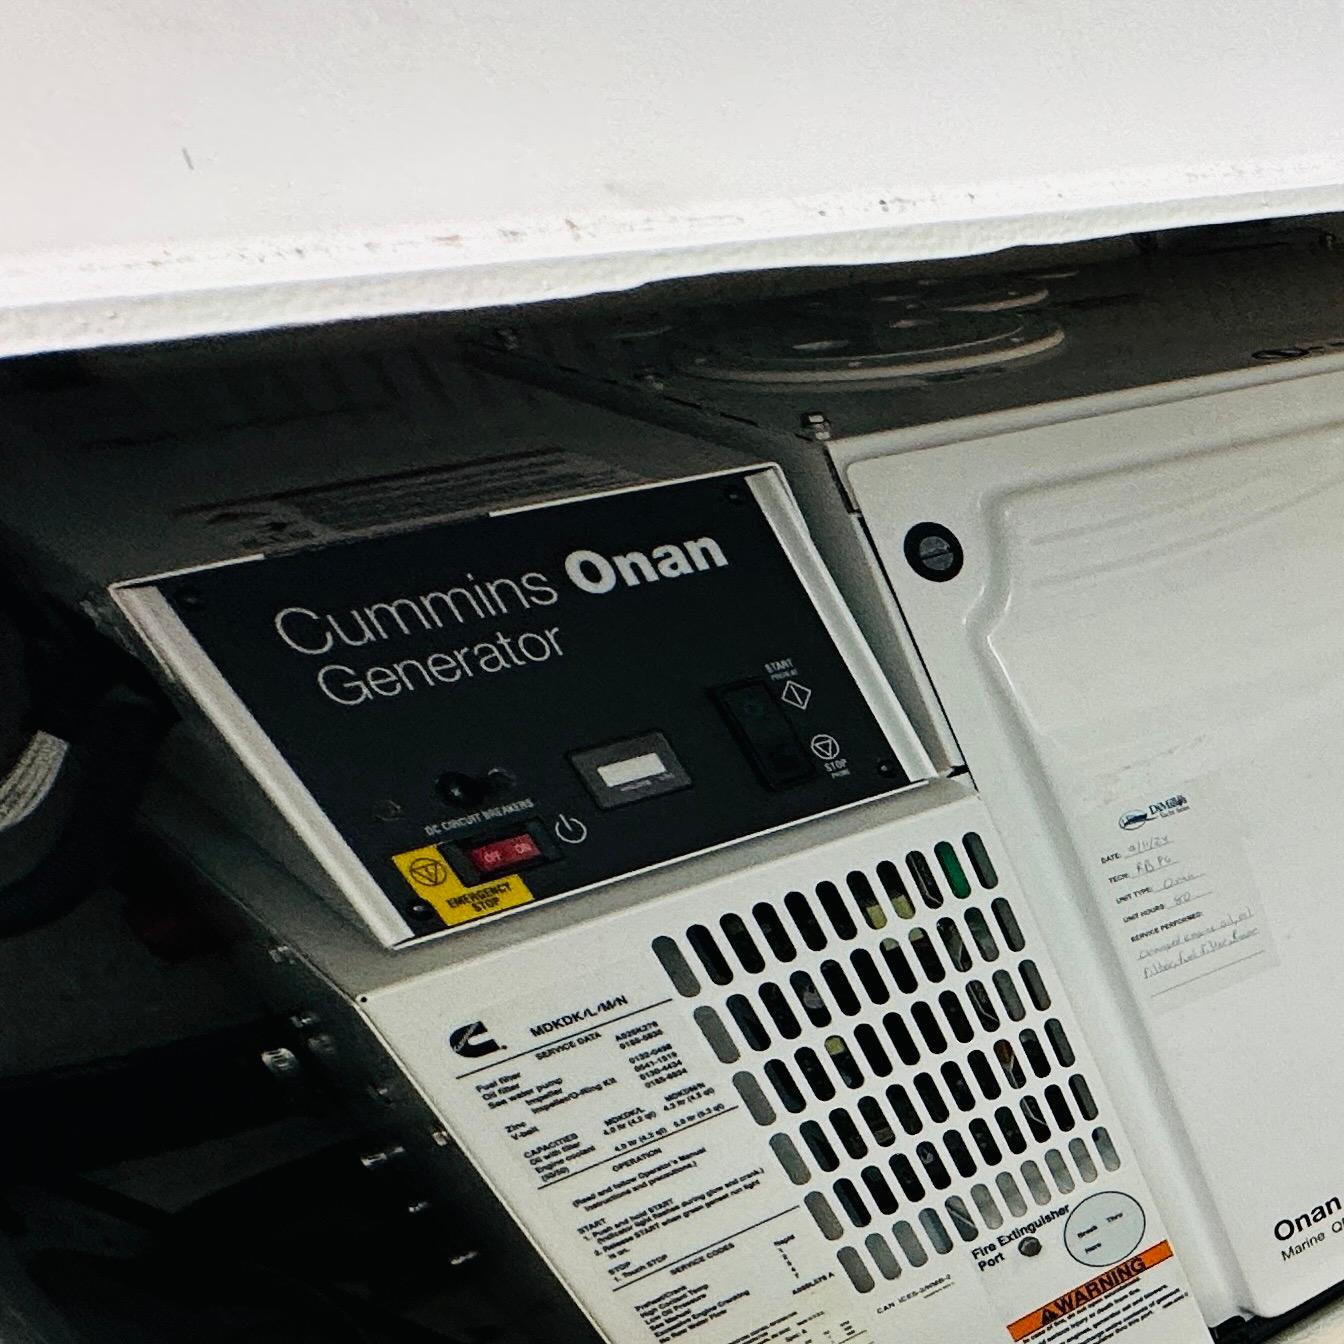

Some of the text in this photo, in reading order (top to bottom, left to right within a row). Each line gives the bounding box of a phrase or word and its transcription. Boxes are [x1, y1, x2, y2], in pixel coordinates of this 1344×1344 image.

[274, 536, 729, 658] Cummins Onan
[318, 624, 565, 708] Generator
[764, 658, 794, 674] START
[824, 758, 847, 772] STOP
[424, 798, 535, 836] DC CIRCUIT BREAKERS
[446, 882, 512, 908] EMERGENCY
[470, 897, 501, 912] STOP
[535, 1031, 601, 1060] SERVICE DATA
[475, 1072, 521, 1093] Fuel filter
[497, 1083, 520, 1095] filter
[508, 1088, 534, 1101] water
[535, 1077, 563, 1093] pump
[523, 1132, 578, 1158] CAPACITIES
[561, 1141, 580, 1152] filter
[534, 1158, 565, 1174] Engine
[597, 1185, 613, 1196] and
[612, 1176, 637, 1189] follow
[677, 1147, 706, 1161] Manual
[612, 1147, 662, 1172] OPERATION
[631, 1181, 648, 1192] and
[633, 1216, 653, 1227] light
[681, 1193, 706, 1207] during
[705, 1185, 723, 1197] glow
[724, 1178, 739, 1188] and
[633, 1221, 660, 1238] START
[661, 1214, 682, 1226] when
[682, 1204, 704, 1218] green
[730, 1187, 743, 1196] run
[742, 1179, 760, 1190] light
[577, 1217, 606, 1234] START
[591, 1197, 673, 1238] Push and hold START
[1273, 1196, 1342, 1242] Onan
[971, 1204, 1074, 1260] Fire Extinguisher
[1281, 1231, 1326, 1261] Marine
[607, 1261, 631, 1275] STOP
[645, 1254, 668, 1267] STOP
[670, 1242, 736, 1278] SERVICE CODES
[977, 1252, 1005, 1272] Port
[1053, 1256, 1147, 1315] WARNING
[1030, 1329, 1046, 1340] case
[1064, 1312, 1075, 1320] do
[1076, 1306, 1087, 1314] not
